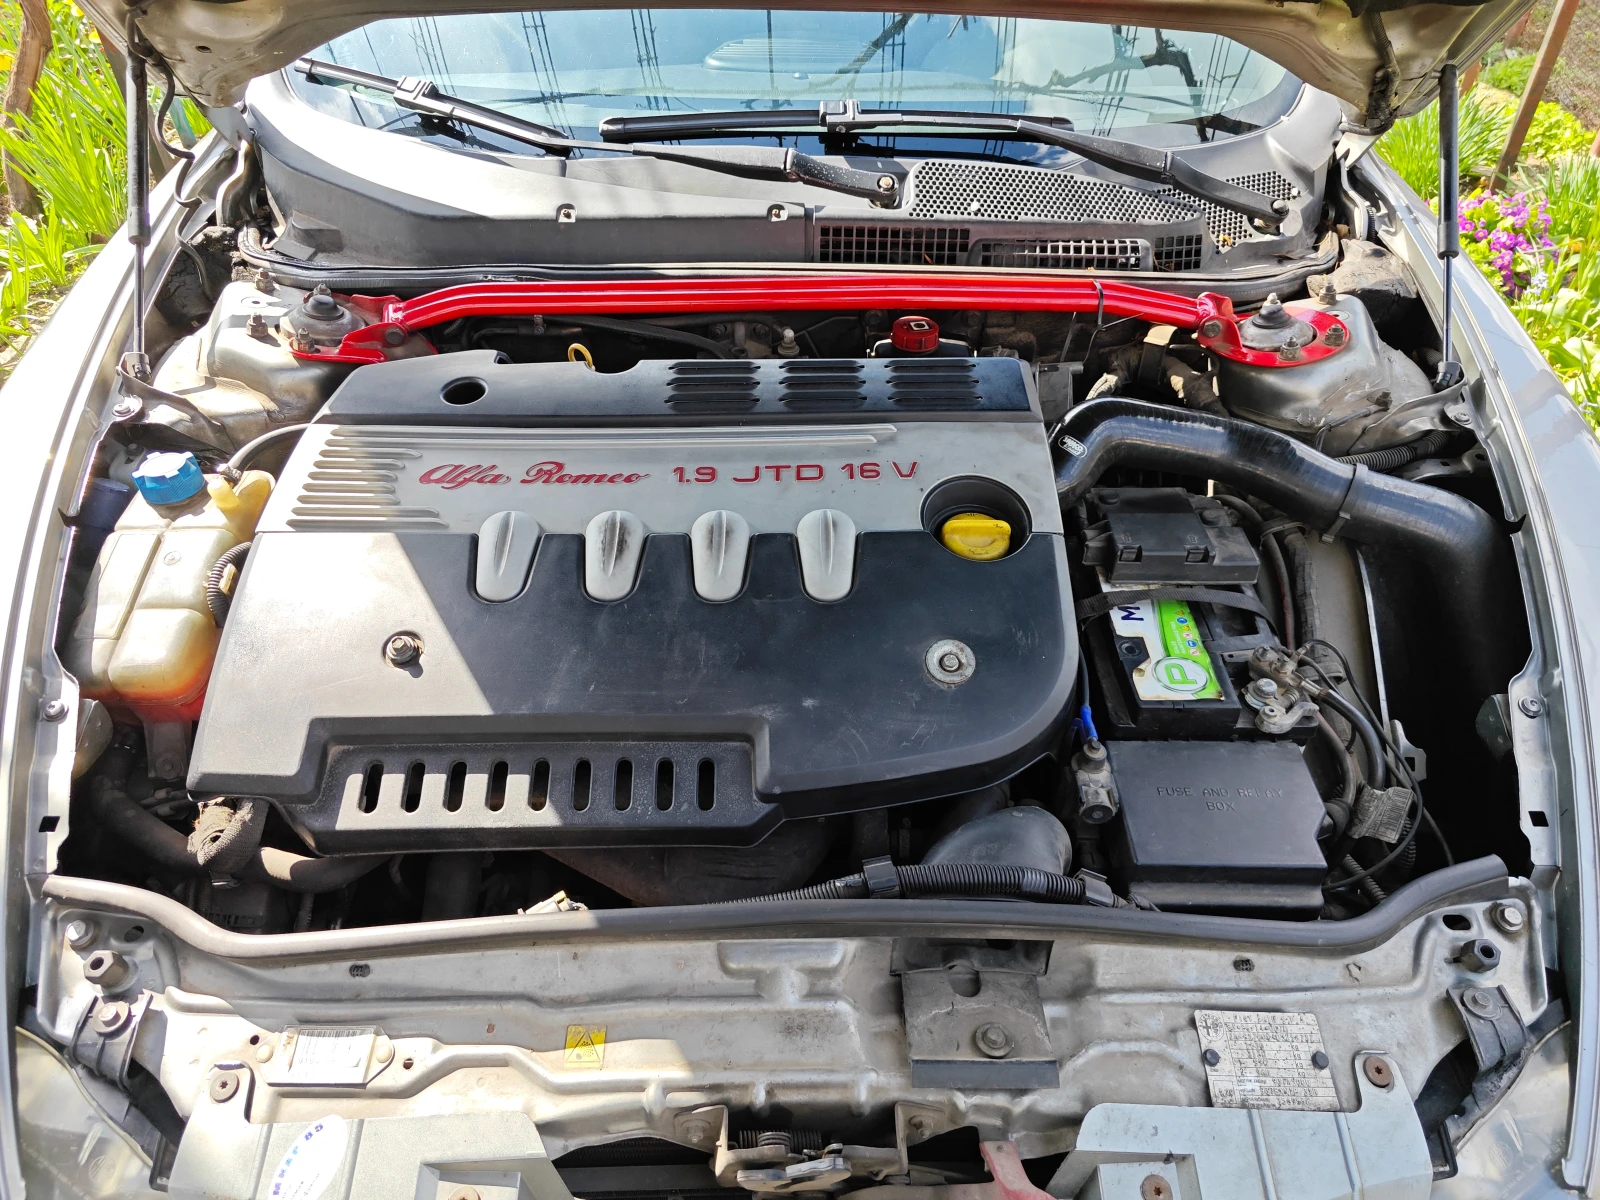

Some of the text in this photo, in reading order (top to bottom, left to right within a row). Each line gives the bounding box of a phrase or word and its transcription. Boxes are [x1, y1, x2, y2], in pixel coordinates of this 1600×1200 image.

[419, 461, 918, 490] Alfa Romeo 1.9 JTD 16 V
[1164, 663, 1197, 684] P
[1156, 787, 1192, 797] FUSE
[1202, 788, 1229, 797] AND
[1206, 801, 1235, 811] BOX
